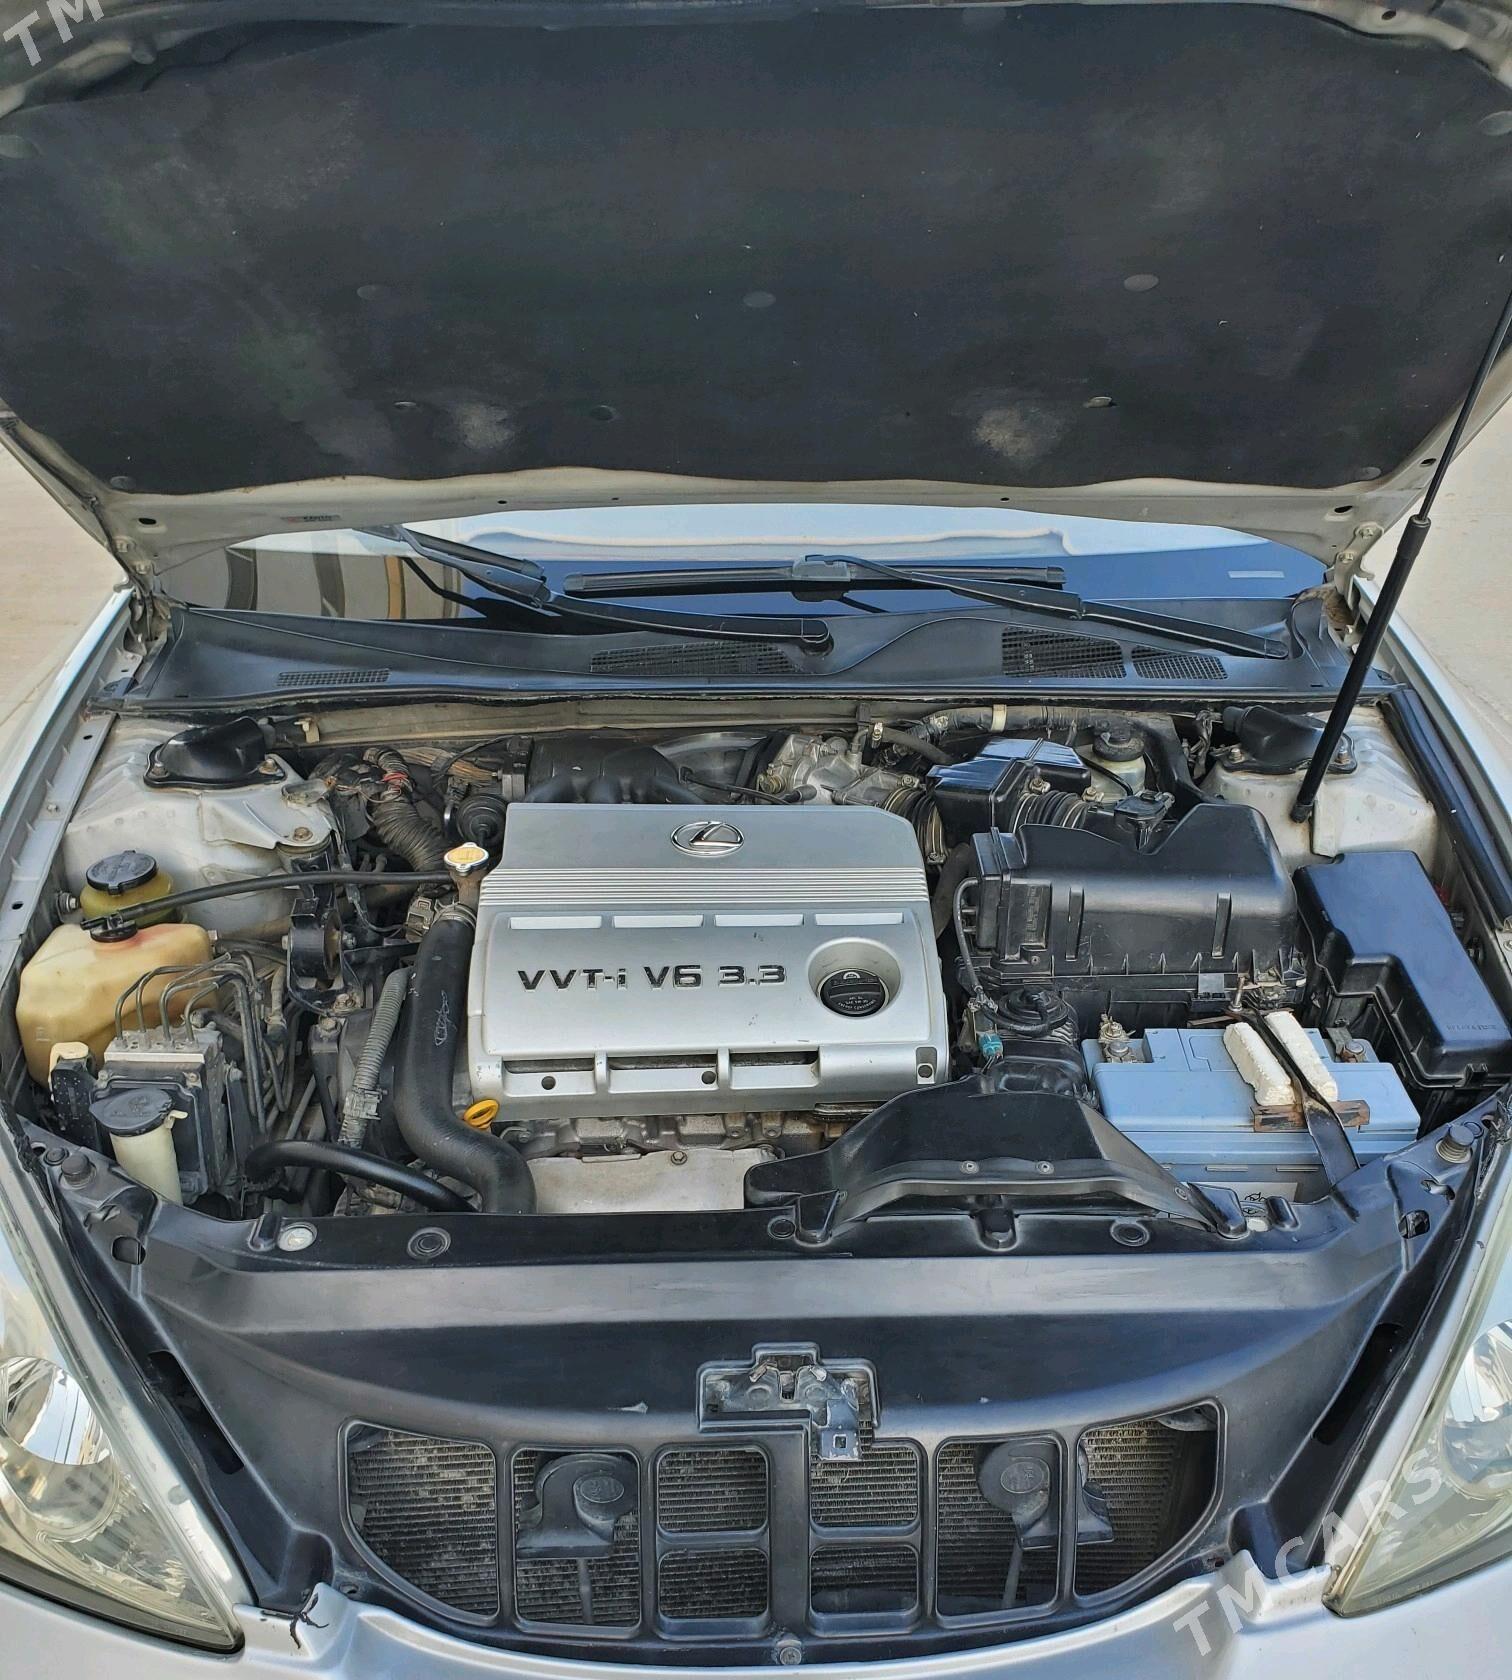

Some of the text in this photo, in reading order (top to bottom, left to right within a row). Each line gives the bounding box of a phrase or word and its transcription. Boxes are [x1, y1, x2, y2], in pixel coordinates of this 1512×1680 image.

[517, 965, 788, 992] VVT-i V6 3.3
